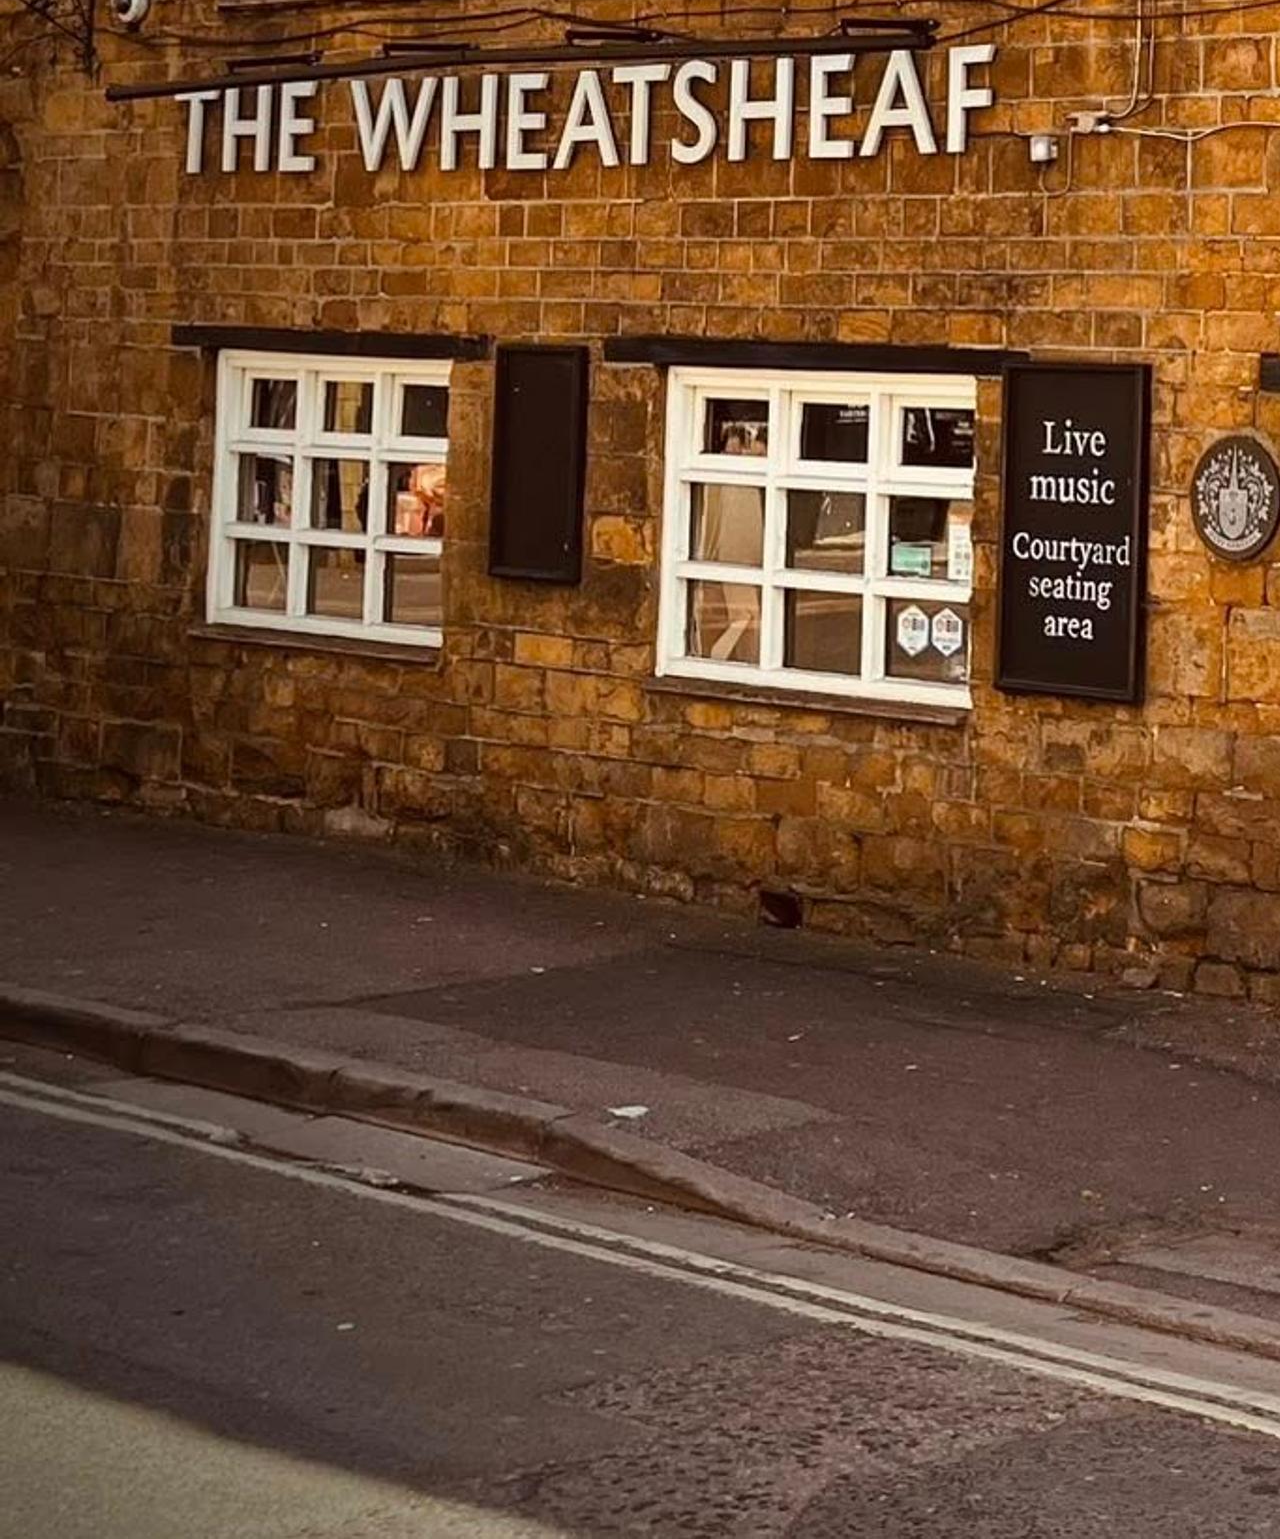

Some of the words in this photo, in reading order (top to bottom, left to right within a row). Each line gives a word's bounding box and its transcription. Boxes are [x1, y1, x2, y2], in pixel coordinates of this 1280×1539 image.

[174, 80, 318, 175] THE
[350, 43, 998, 173] WHEATSHEAF
[1042, 418, 1106, 457] Live
[1029, 469, 1116, 504] music
[1012, 532, 1131, 570] Courtyard
[1028, 572, 1113, 610] seating
[1043, 614, 1094, 640] area
